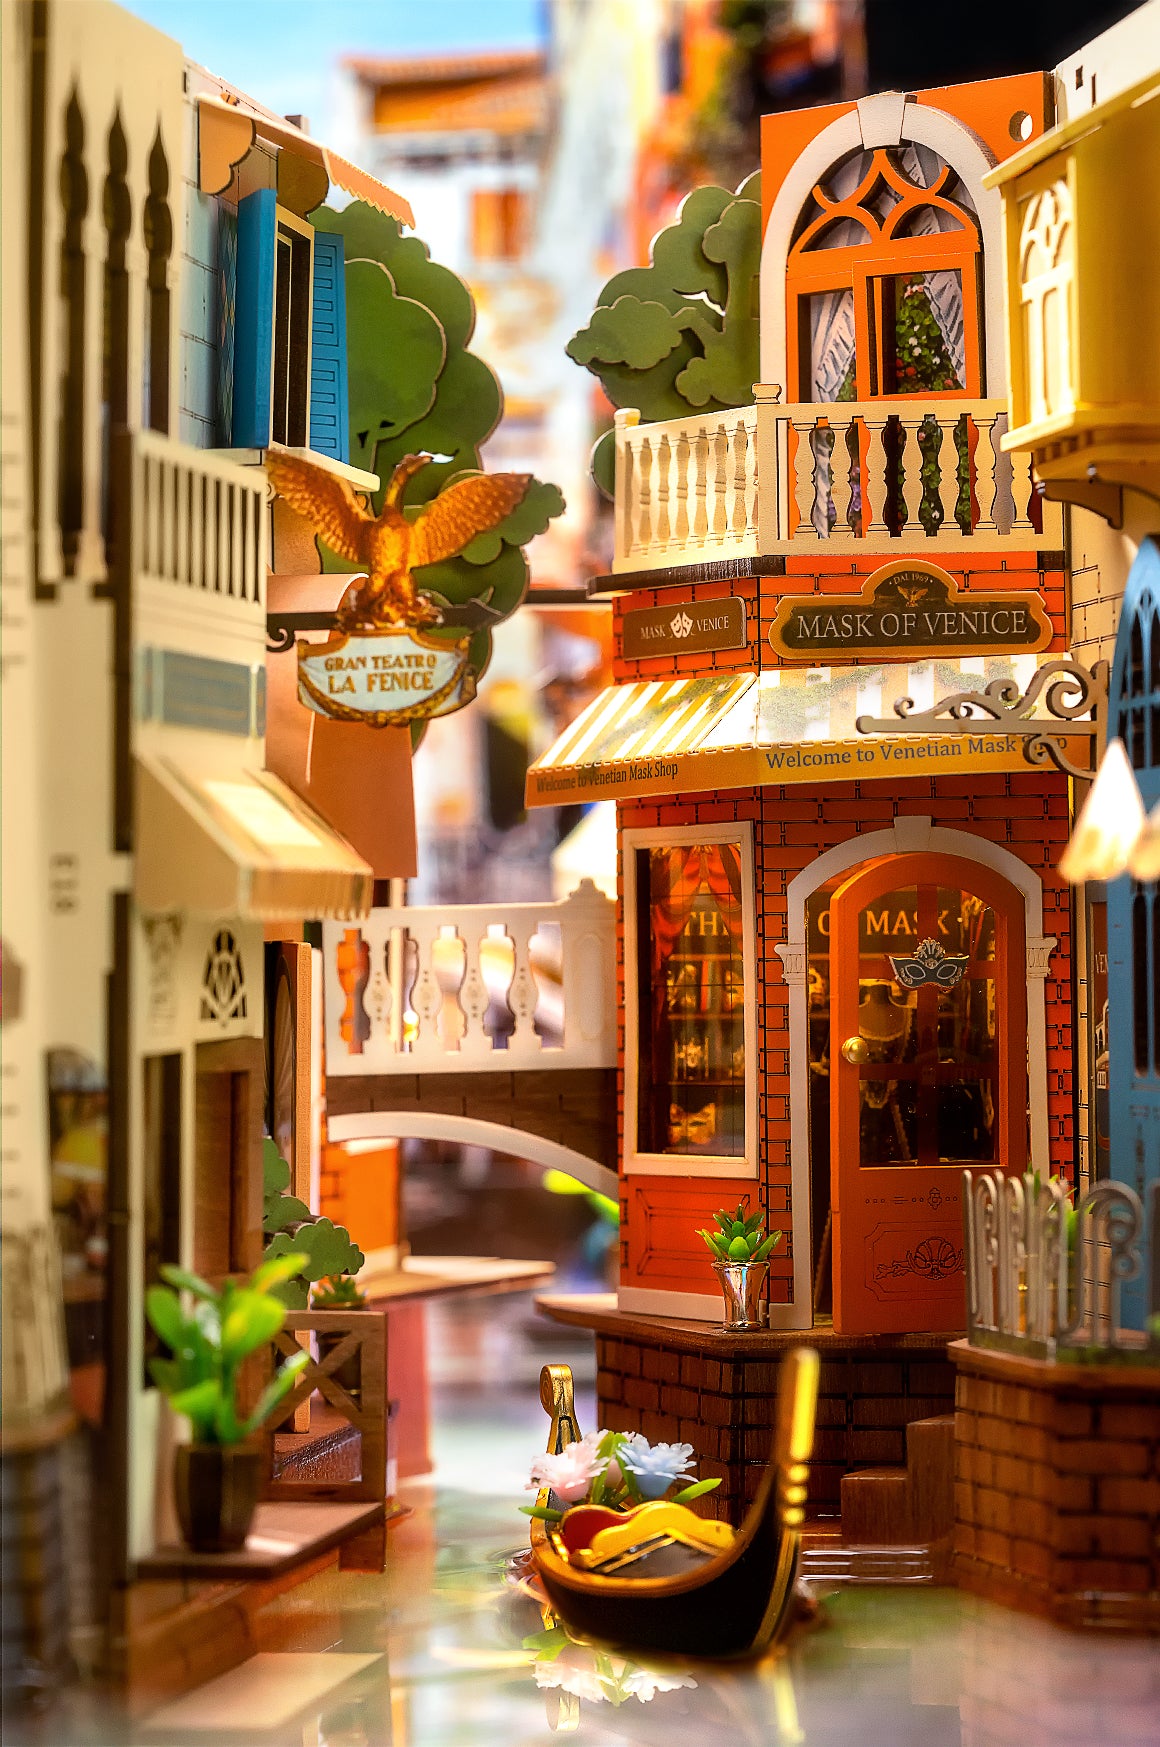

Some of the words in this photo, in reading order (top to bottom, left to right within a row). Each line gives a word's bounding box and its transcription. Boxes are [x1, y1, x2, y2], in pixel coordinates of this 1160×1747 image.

[893, 573, 910, 585] DAL
[640, 624, 666, 640] MASK
[696, 615, 730, 632] VENICE
[797, 613, 874, 639] MASK
[880, 612, 916, 637] OF
[923, 610, 1028, 636] VENICE
[324, 656, 367, 671] GRAN
[371, 654, 437, 670] TEATRO
[328, 675, 356, 694] LA
[367, 671, 434, 692] FENICE
[766, 750, 851, 769] Welcome
[856, 748, 875, 762] to
[880, 741, 962, 761] Venetian
[968, 736, 1016, 754] Mask
[536, 774, 576, 792] Welcome
[578, 771, 586, 786] to
[588, 767, 626, 786] Venetian
[629, 763, 653, 781] Mask
[654, 761, 678, 780] Shop
